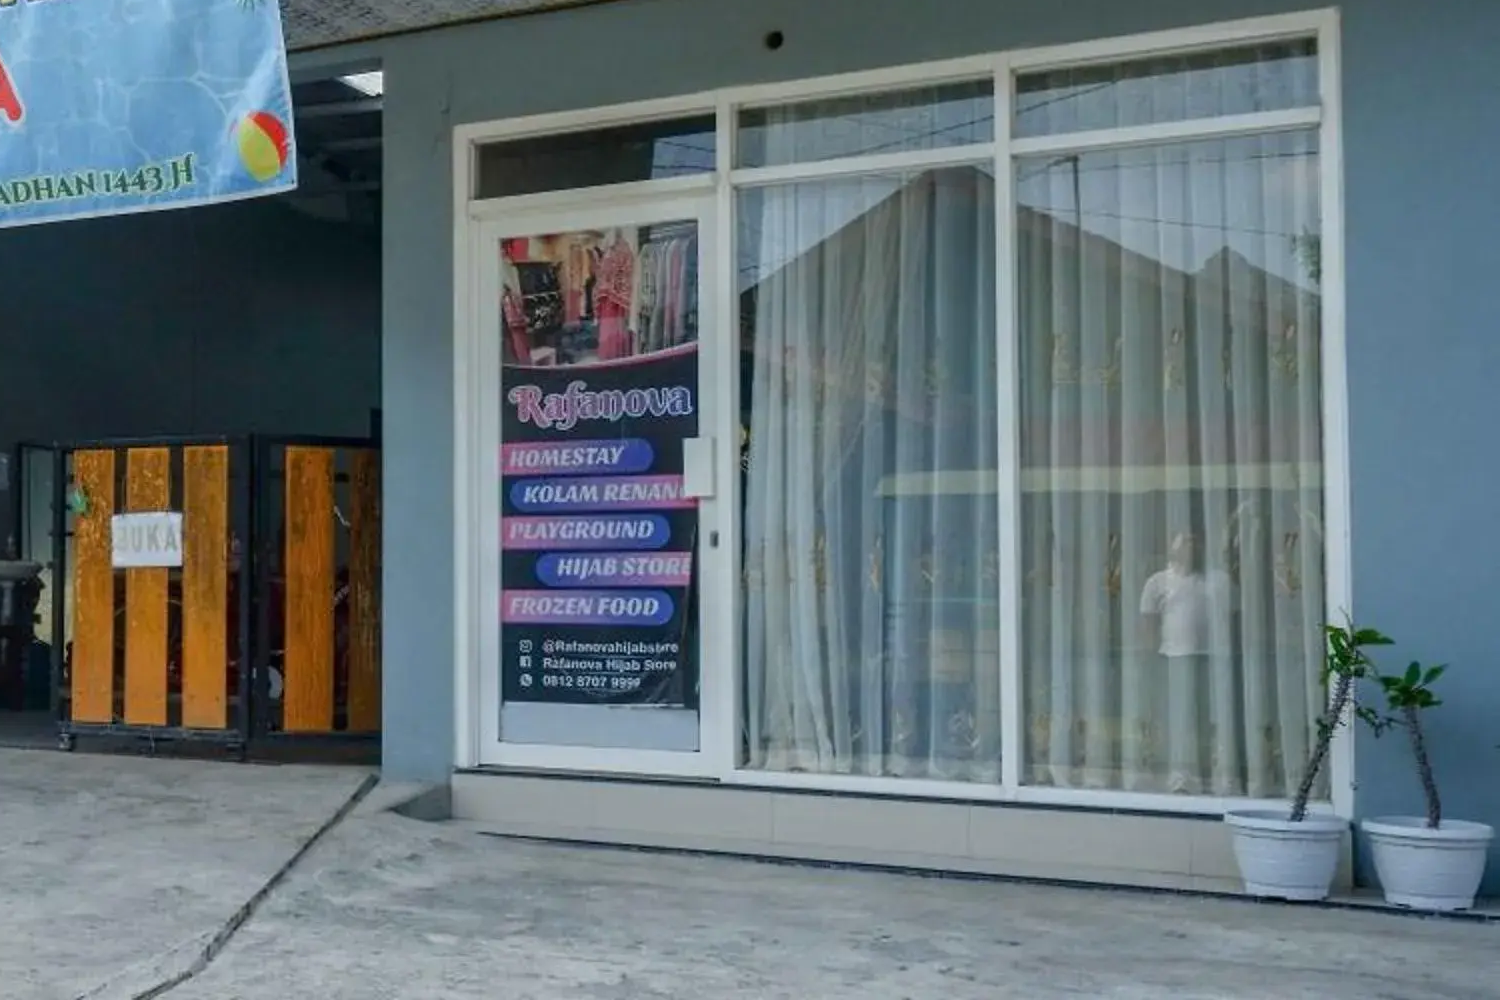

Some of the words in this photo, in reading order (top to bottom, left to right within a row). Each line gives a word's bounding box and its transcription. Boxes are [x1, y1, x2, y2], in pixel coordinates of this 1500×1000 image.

[103, 166, 163, 194] 1443
[508, 380, 693, 431] Rafanova
[509, 446, 625, 468] HOMESTAY
[523, 485, 602, 504] KOLAM
[603, 481, 684, 501] RENAN
[116, 524, 178, 552] BUKA
[510, 519, 654, 540] PLAYGROUND
[556, 557, 618, 580] HIJAB
[510, 597, 597, 617] FROZEN
[597, 597, 660, 616] FOOD
